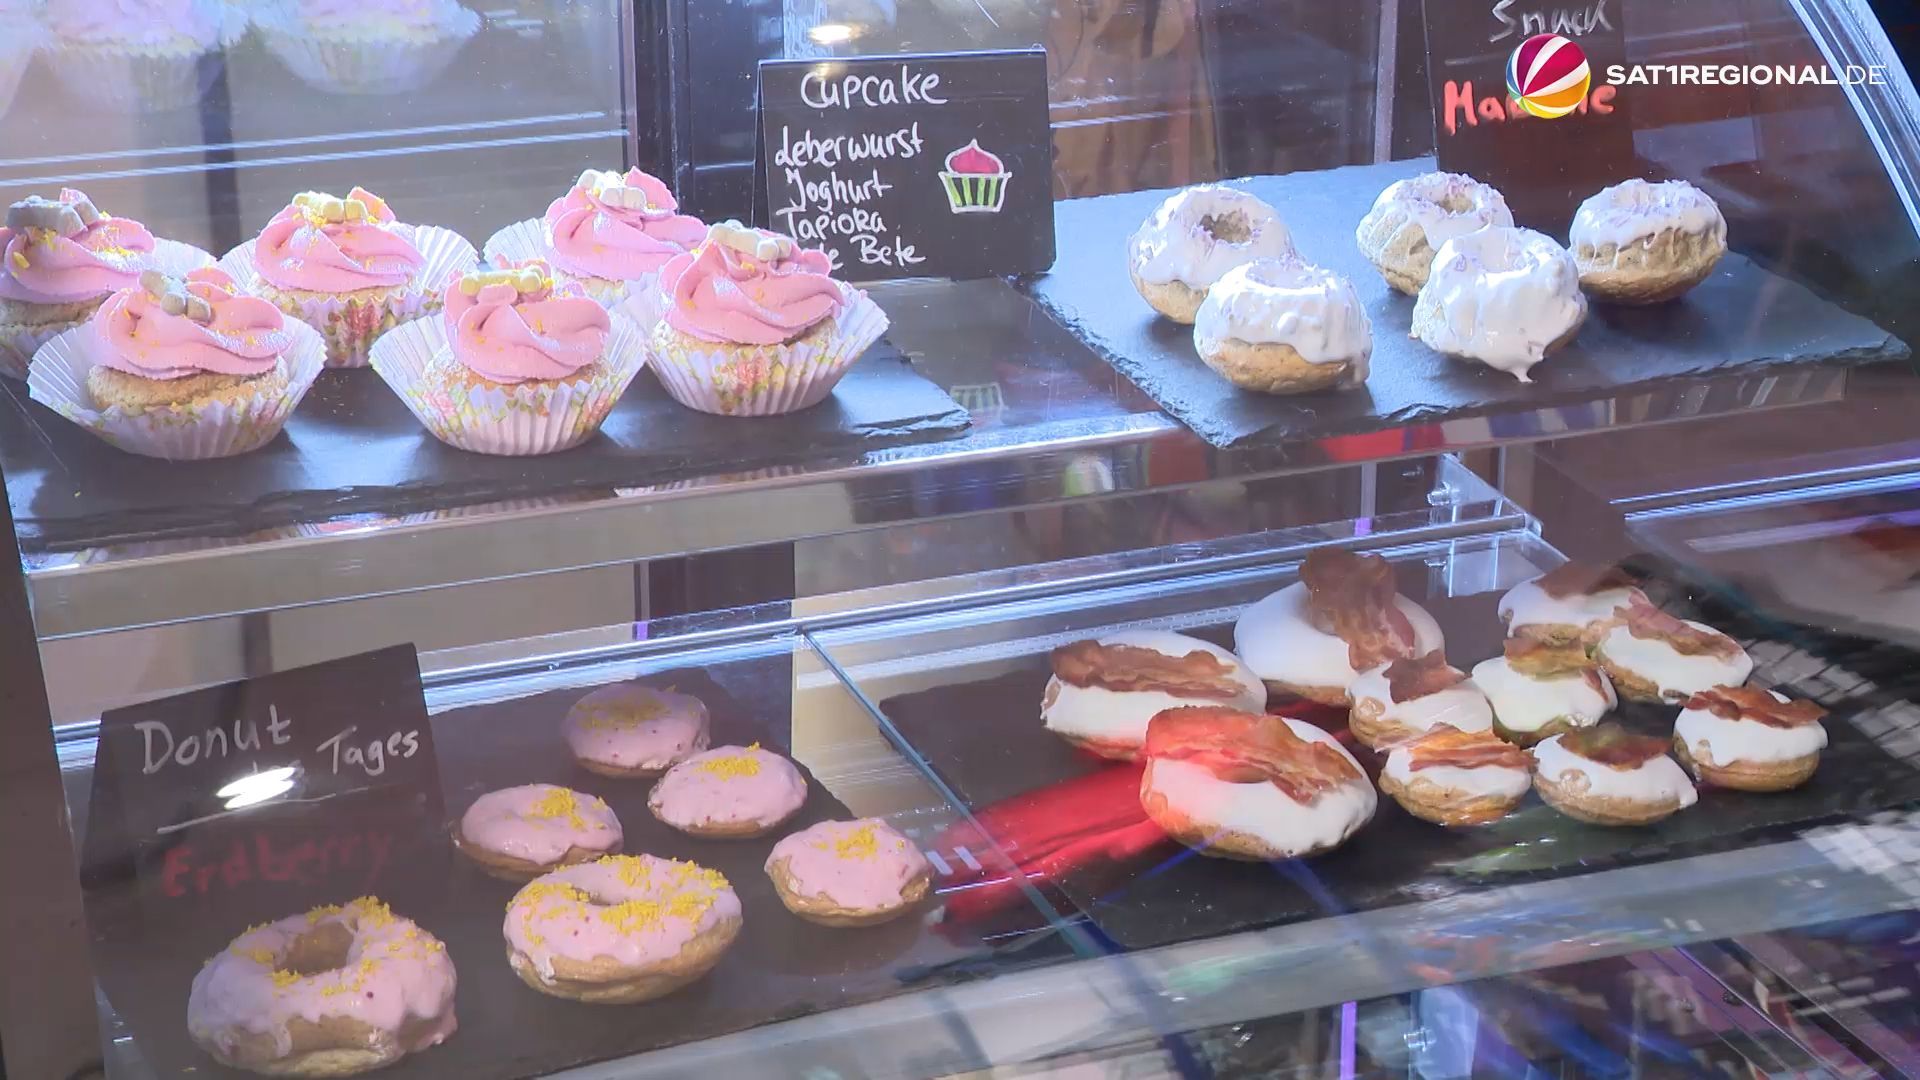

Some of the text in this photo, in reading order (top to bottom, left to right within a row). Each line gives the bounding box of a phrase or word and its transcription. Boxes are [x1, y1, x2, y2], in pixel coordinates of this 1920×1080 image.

[800, 66, 948, 109] Cupcake
[785, 168, 893, 212] Joghurt
[776, 209, 887, 240] Tapioka
[849, 234, 927, 267] Bete
[134, 704, 291, 774] Donut
[316, 725, 419, 776] Tages
